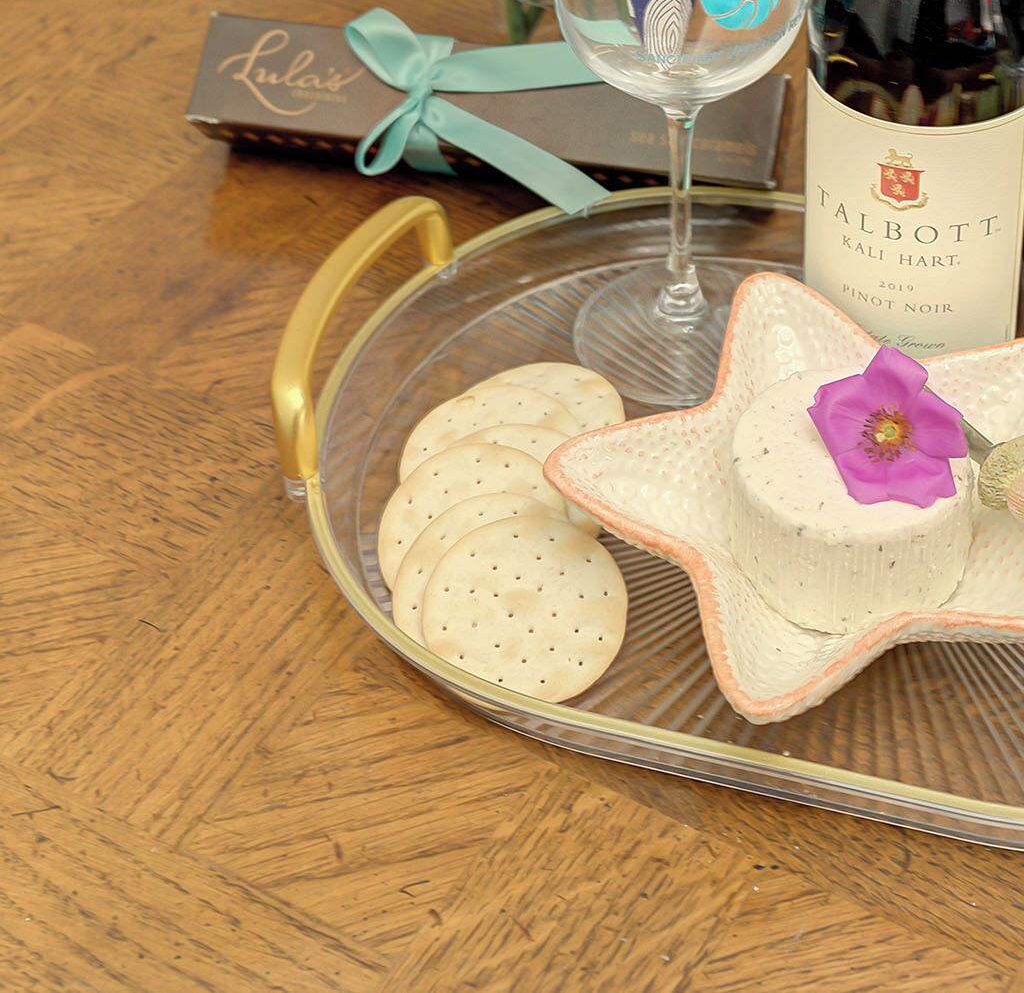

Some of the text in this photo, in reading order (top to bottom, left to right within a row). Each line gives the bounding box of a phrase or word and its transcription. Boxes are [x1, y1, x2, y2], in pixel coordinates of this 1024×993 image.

[817, 185, 999, 244] TALBOTT
[842, 235, 884, 261] KALI
[843, 283, 953, 314] PINOT NOIR
[879, 280, 914, 292] 2019
[896, 334, 946, 350] Grown
